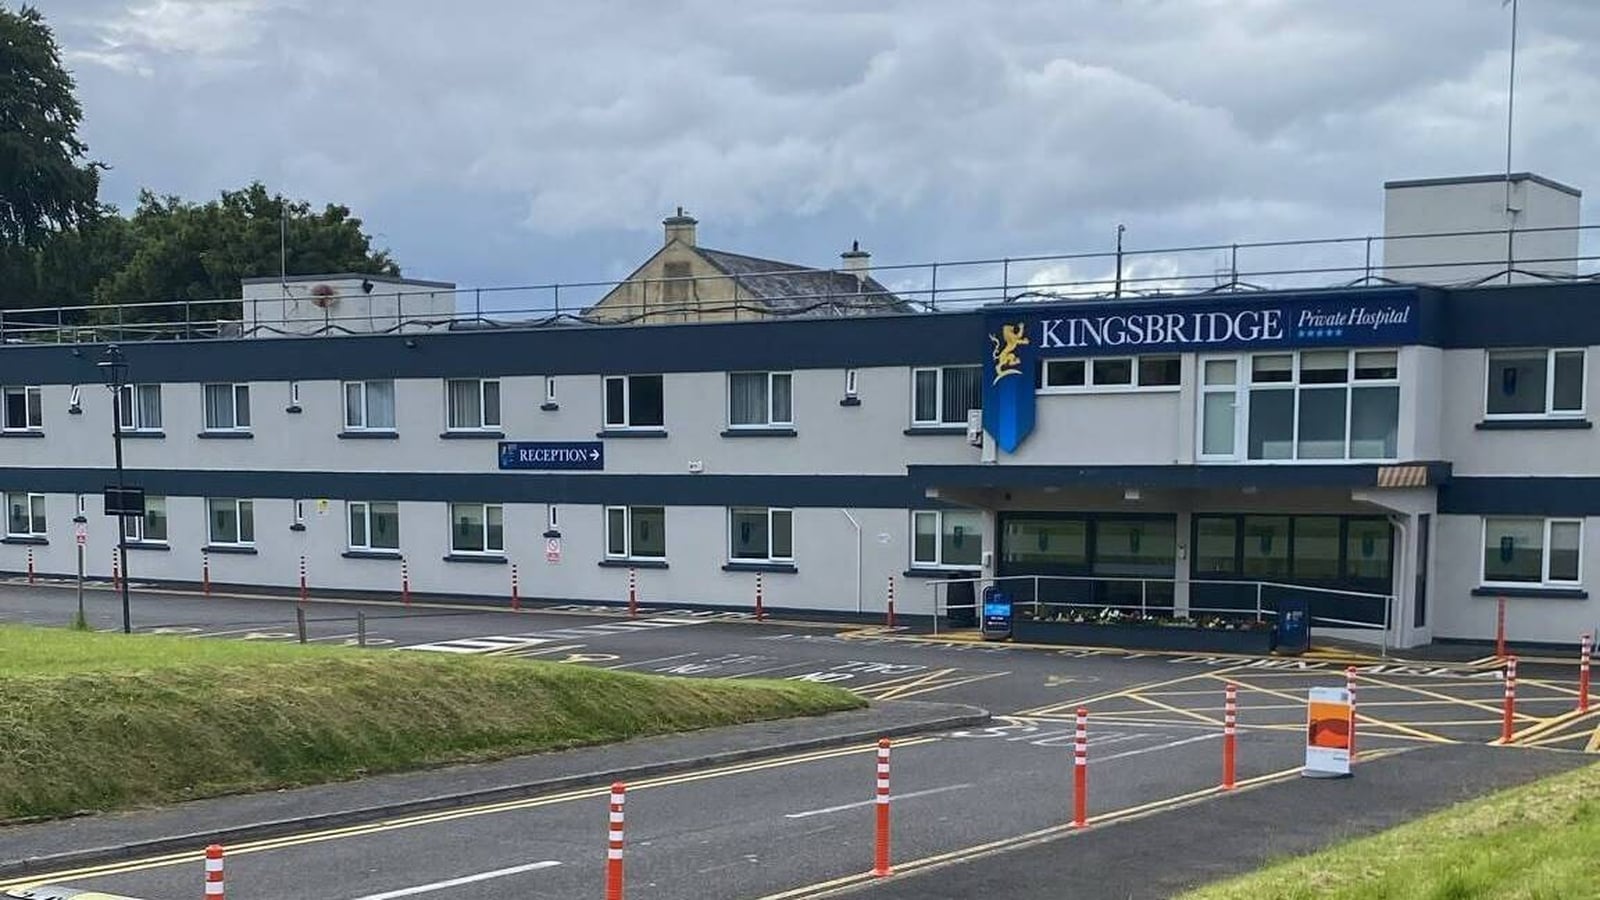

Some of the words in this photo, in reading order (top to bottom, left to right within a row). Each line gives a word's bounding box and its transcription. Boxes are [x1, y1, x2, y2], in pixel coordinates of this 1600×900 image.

[1298, 310, 1346, 327] Private
[1346, 306, 1410, 329] Hospital
[1039, 310, 1282, 349] KINGSBRIDGE
[519, 449, 587, 461] RECEPTION
